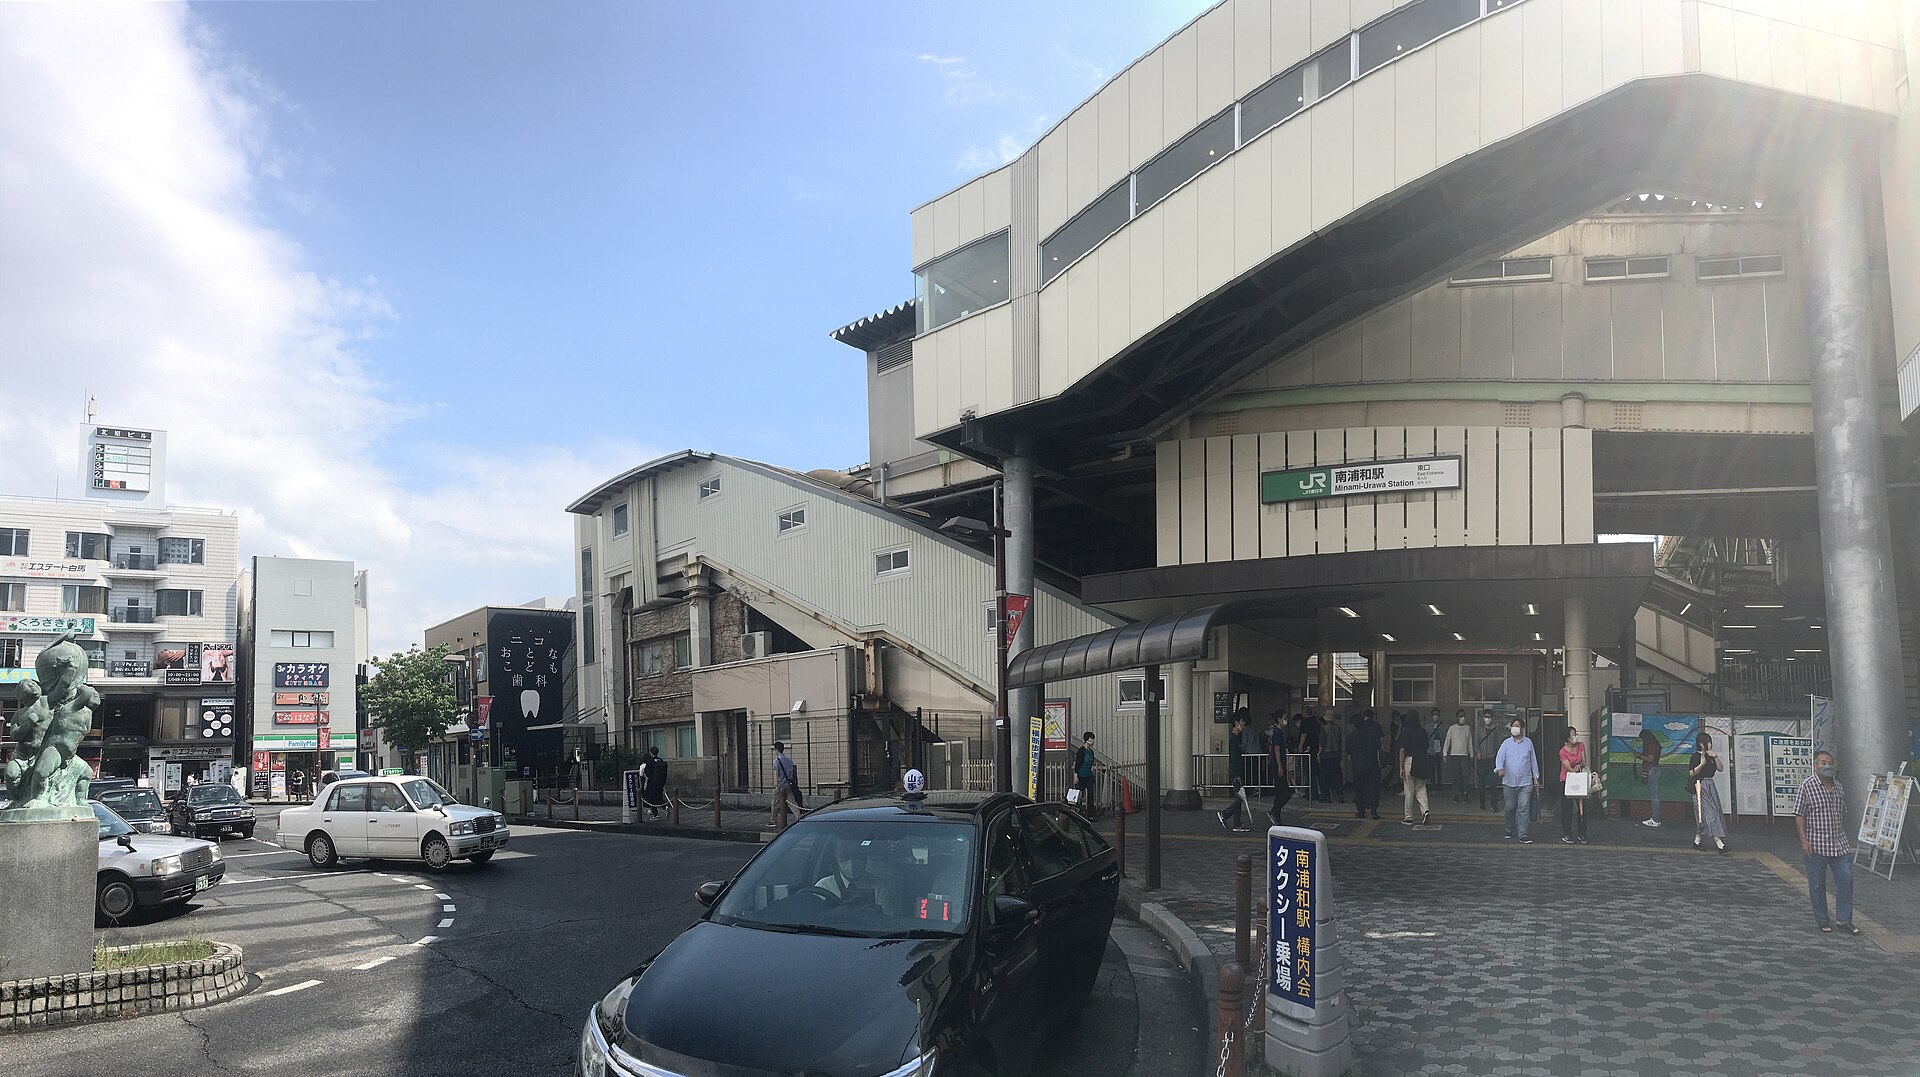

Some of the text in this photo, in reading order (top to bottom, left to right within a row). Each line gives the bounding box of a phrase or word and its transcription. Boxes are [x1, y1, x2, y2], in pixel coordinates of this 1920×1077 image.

[1299, 472, 1327, 489] JR
[1334, 467, 1385, 483] 南浦和駅
[1334, 482, 1387, 492] Minami-Urawa
[1387, 479, 1415, 488] Station
[27, 562, 87, 572] エステート白馬
[510, 635, 544, 646] ニコ
[500, 646, 558, 660] おとな
[286, 663, 327, 674] カラオケ
[503, 661, 558, 674] こども
[511, 674, 548, 687] 歯科
[288, 740, 318, 748] FamilyMar
[1275, 844, 1292, 992] タクシー乗場
[1295, 849, 1311, 999] 南浦和駅 構内会
